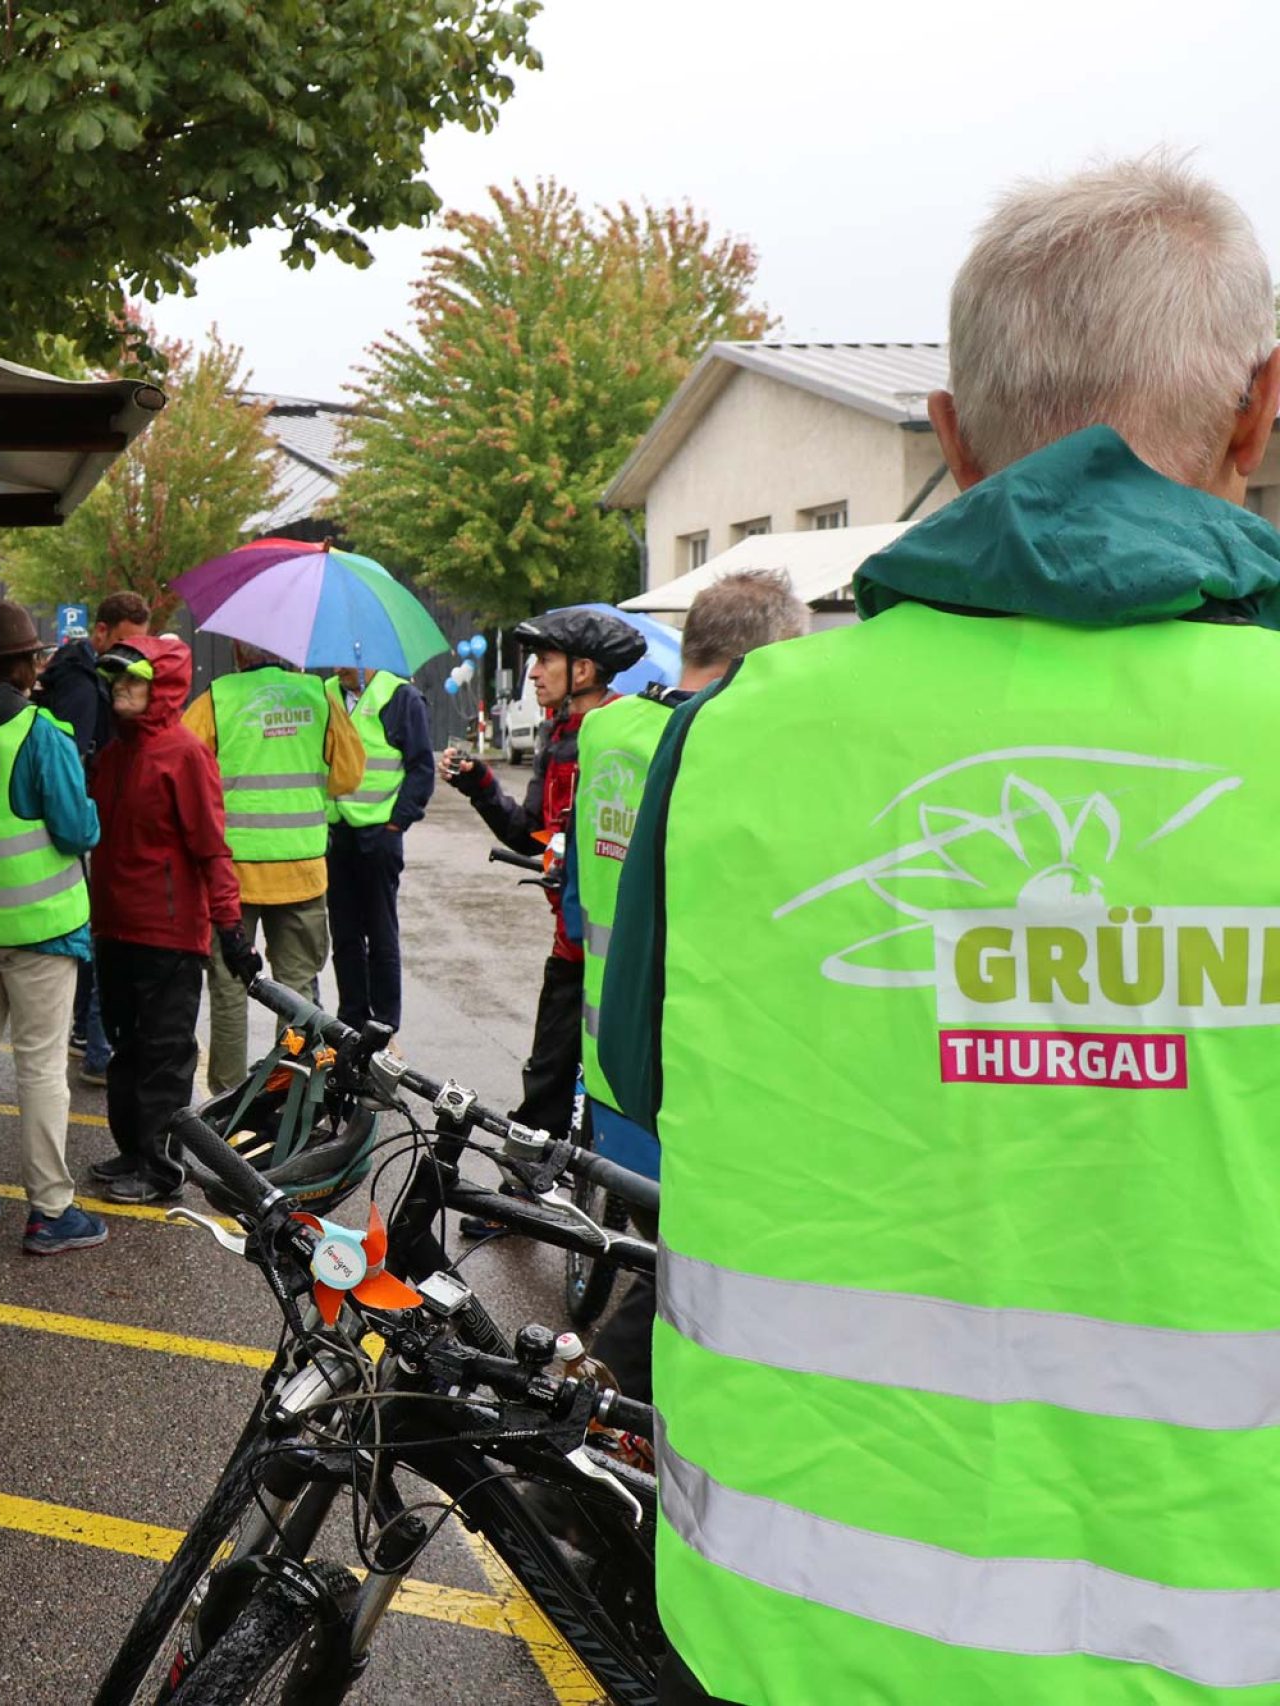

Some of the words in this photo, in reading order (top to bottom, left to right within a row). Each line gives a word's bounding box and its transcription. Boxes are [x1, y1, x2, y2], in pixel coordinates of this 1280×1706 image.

[600, 806, 637, 838] GRÜ
[947, 1038, 1177, 1082] THURGAU
[322, 1244, 353, 1279] famigros
